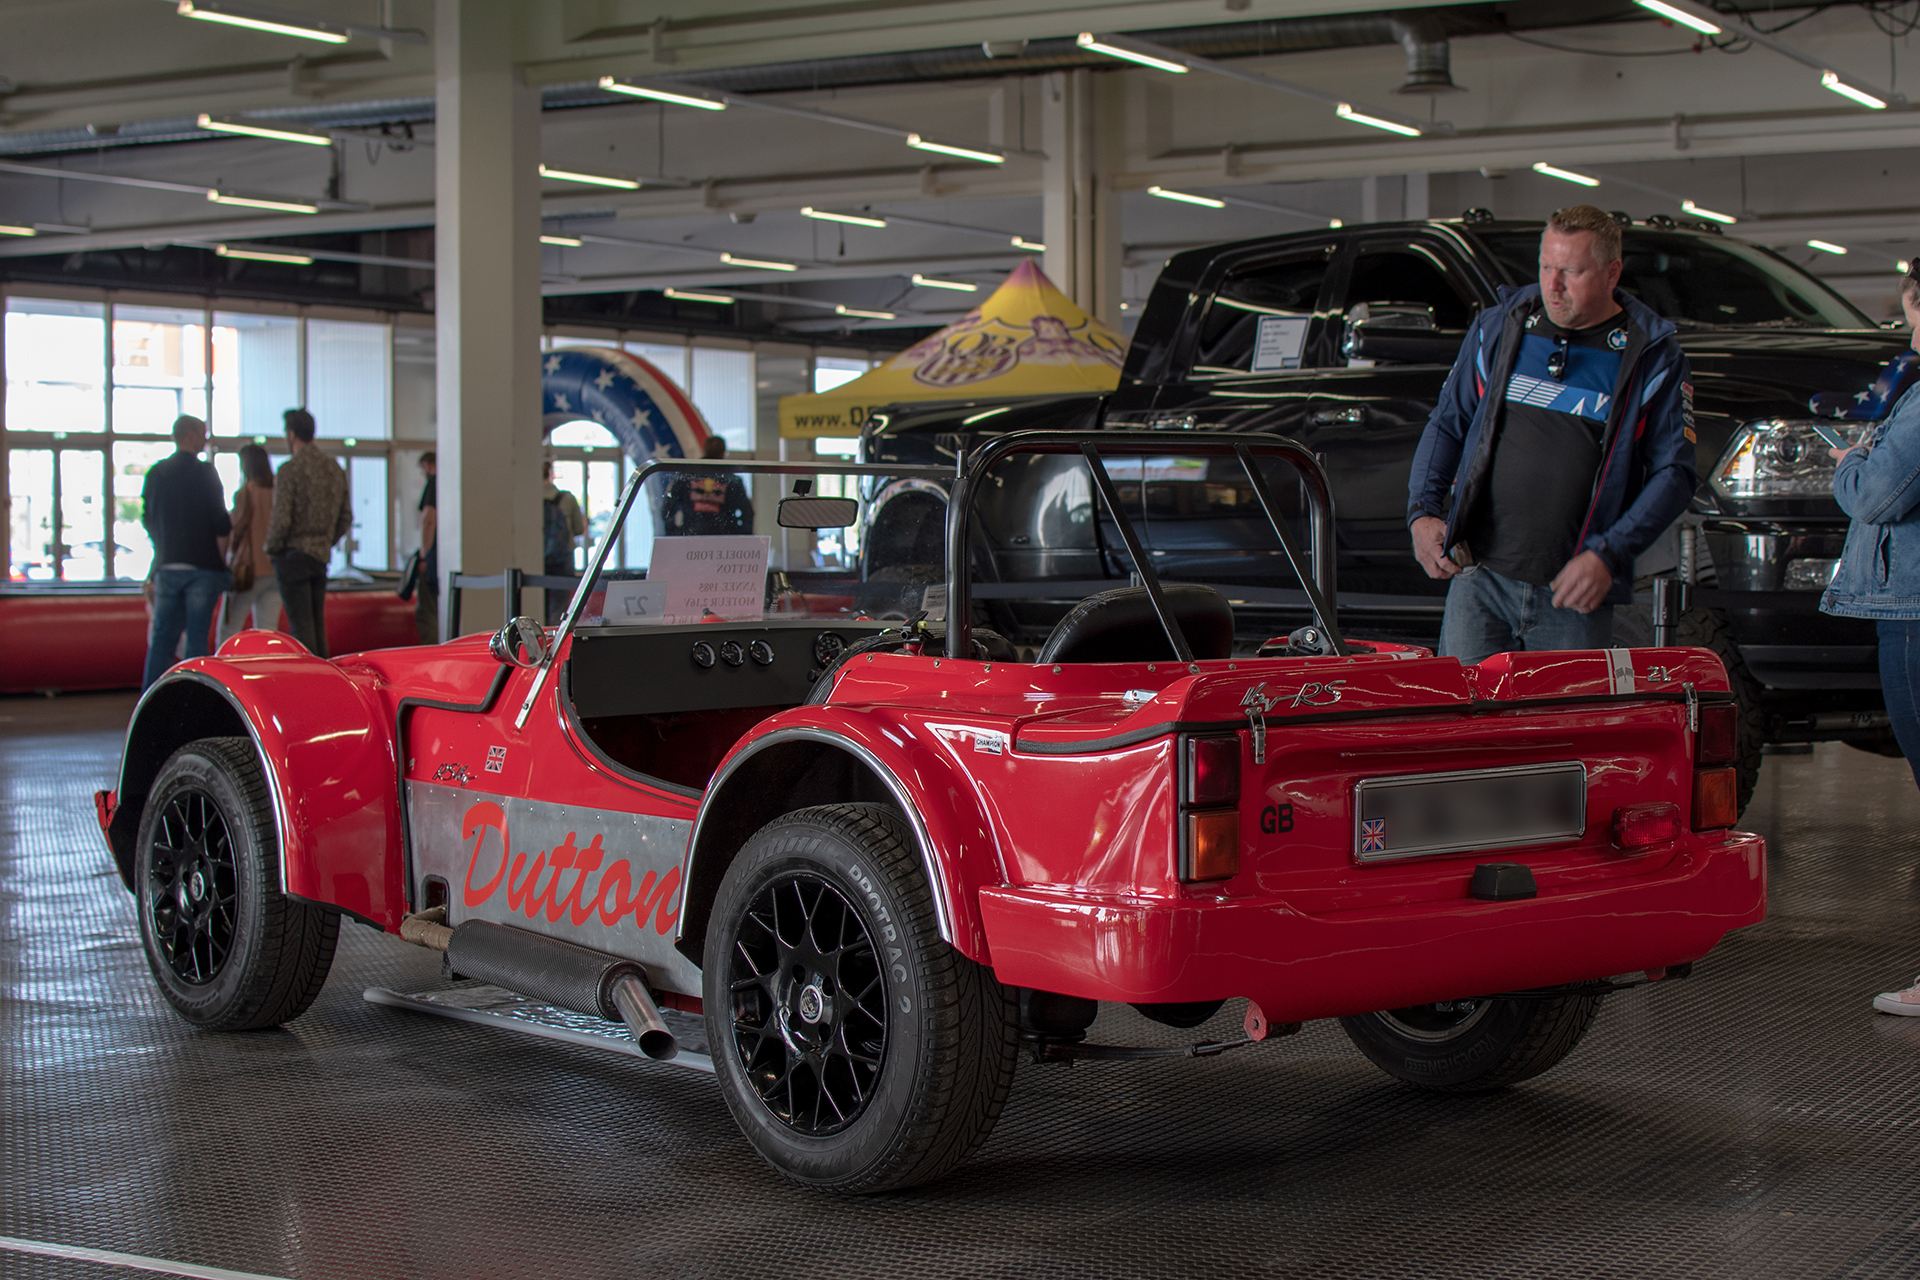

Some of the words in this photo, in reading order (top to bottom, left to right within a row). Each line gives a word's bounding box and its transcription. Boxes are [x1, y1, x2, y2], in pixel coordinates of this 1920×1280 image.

[794, 406, 876, 428] www.Q
[975, 738, 1001, 748] CHAMPION
[1260, 803, 1294, 834] GB
[462, 801, 681, 936] Dutton
[849, 864, 908, 986] PROTRAC
